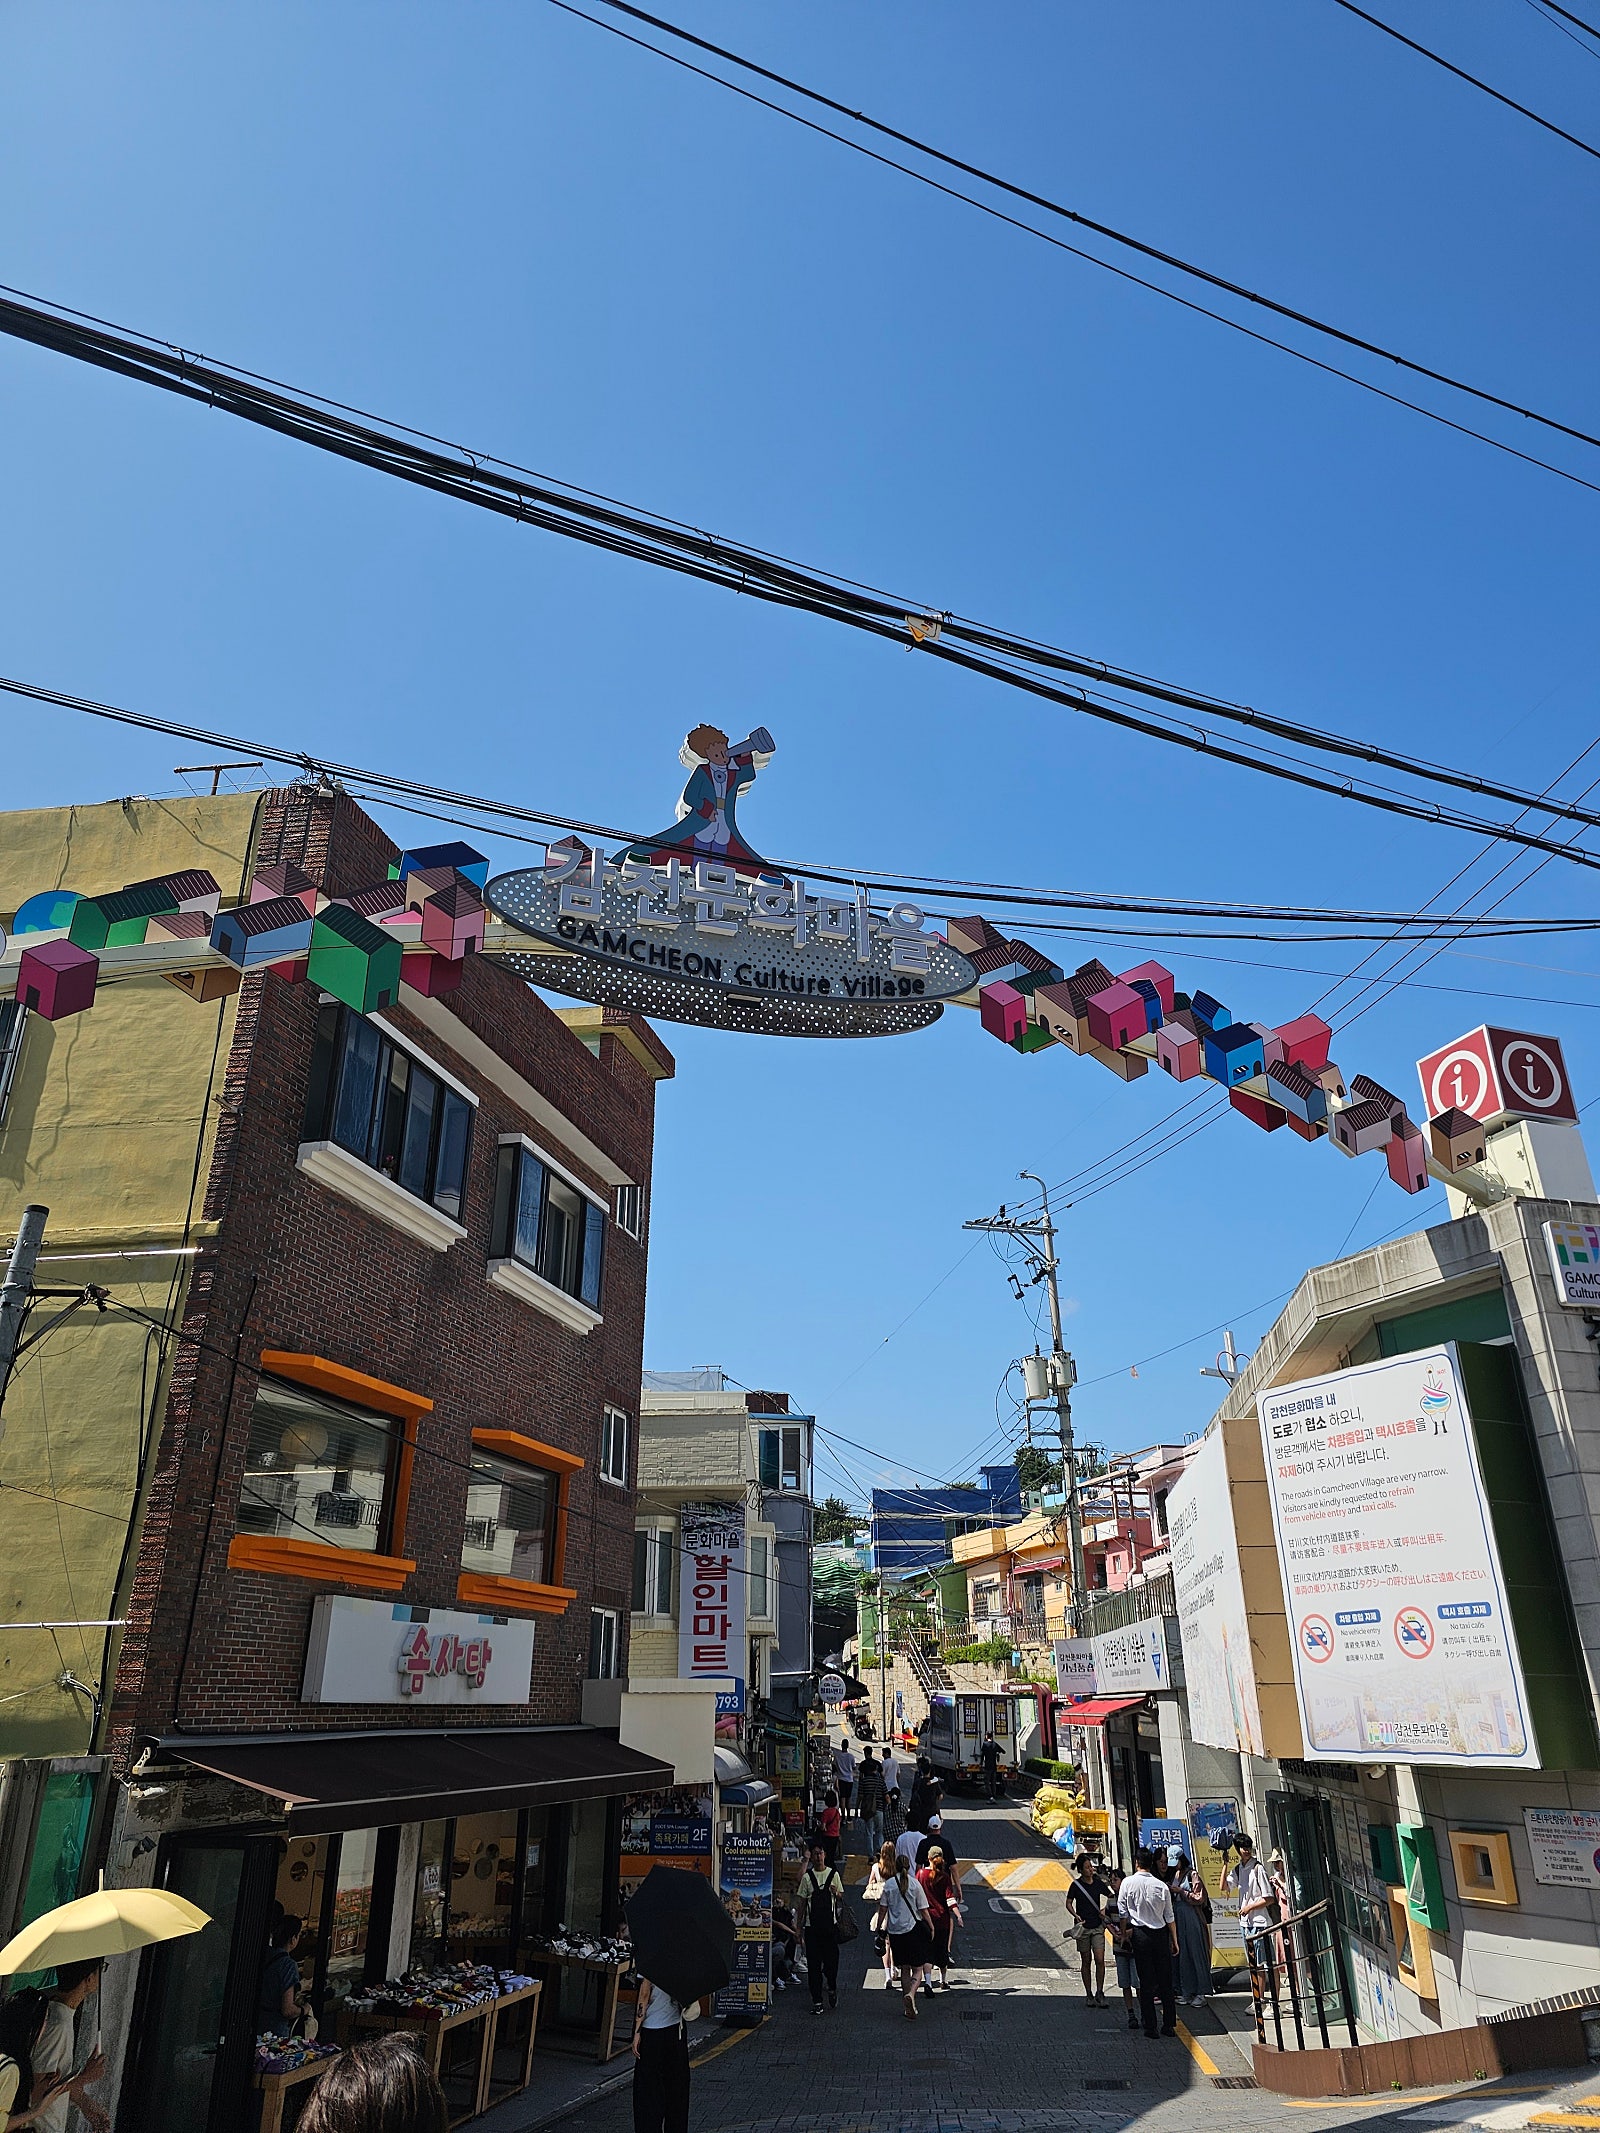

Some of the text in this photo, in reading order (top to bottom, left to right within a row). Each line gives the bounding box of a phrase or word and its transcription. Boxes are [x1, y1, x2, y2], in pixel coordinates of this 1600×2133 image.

[543, 845, 940, 974] 감천문화마을
[557, 916, 926, 998] GAMCHEON Culture Village
[1270, 1393, 1337, 1419] 감천문화마을 내
[1273, 1407, 1364, 1439] 도로가 협소 하오니,
[1274, 1417, 1427, 1460] 방문객께서는 차량출입과 택시호출을
[1278, 1447, 1390, 1479] 자제하여 주시기 바랍니다.
[1281, 1492, 1294, 1501] The
[1294, 1489, 1313, 1498] roads
[1321, 1481, 1359, 1495] Gamcheon
[1360, 1474, 1385, 1488] Village
[1386, 1475, 1399, 1484] are
[1399, 1472, 1417, 1484] very
[1417, 1467, 1448, 1479] narrow.
[1282, 1485, 1415, 1513] Visitors are kindly requested to refrain
[1284, 1500, 1396, 1524] from vehicle entry and taxi calls.
[686, 1532, 740, 1550] 문화마을
[691, 1554, 732, 1670] 할인마트
[1472, 1621, 1485, 1629] calls
[1349, 1628, 1367, 1636] vehicle
[1367, 1627, 1381, 1636] entry
[398, 1624, 492, 1695] 솜사탕
[1393, 1723, 1449, 1738] 감천문화마을
[692, 1828, 708, 1841] 2F
[732, 1837, 767, 1847] Too hot?
[1151, 1829, 1182, 1843] 무자격
[724, 1847, 771, 1855] Cool down here!
